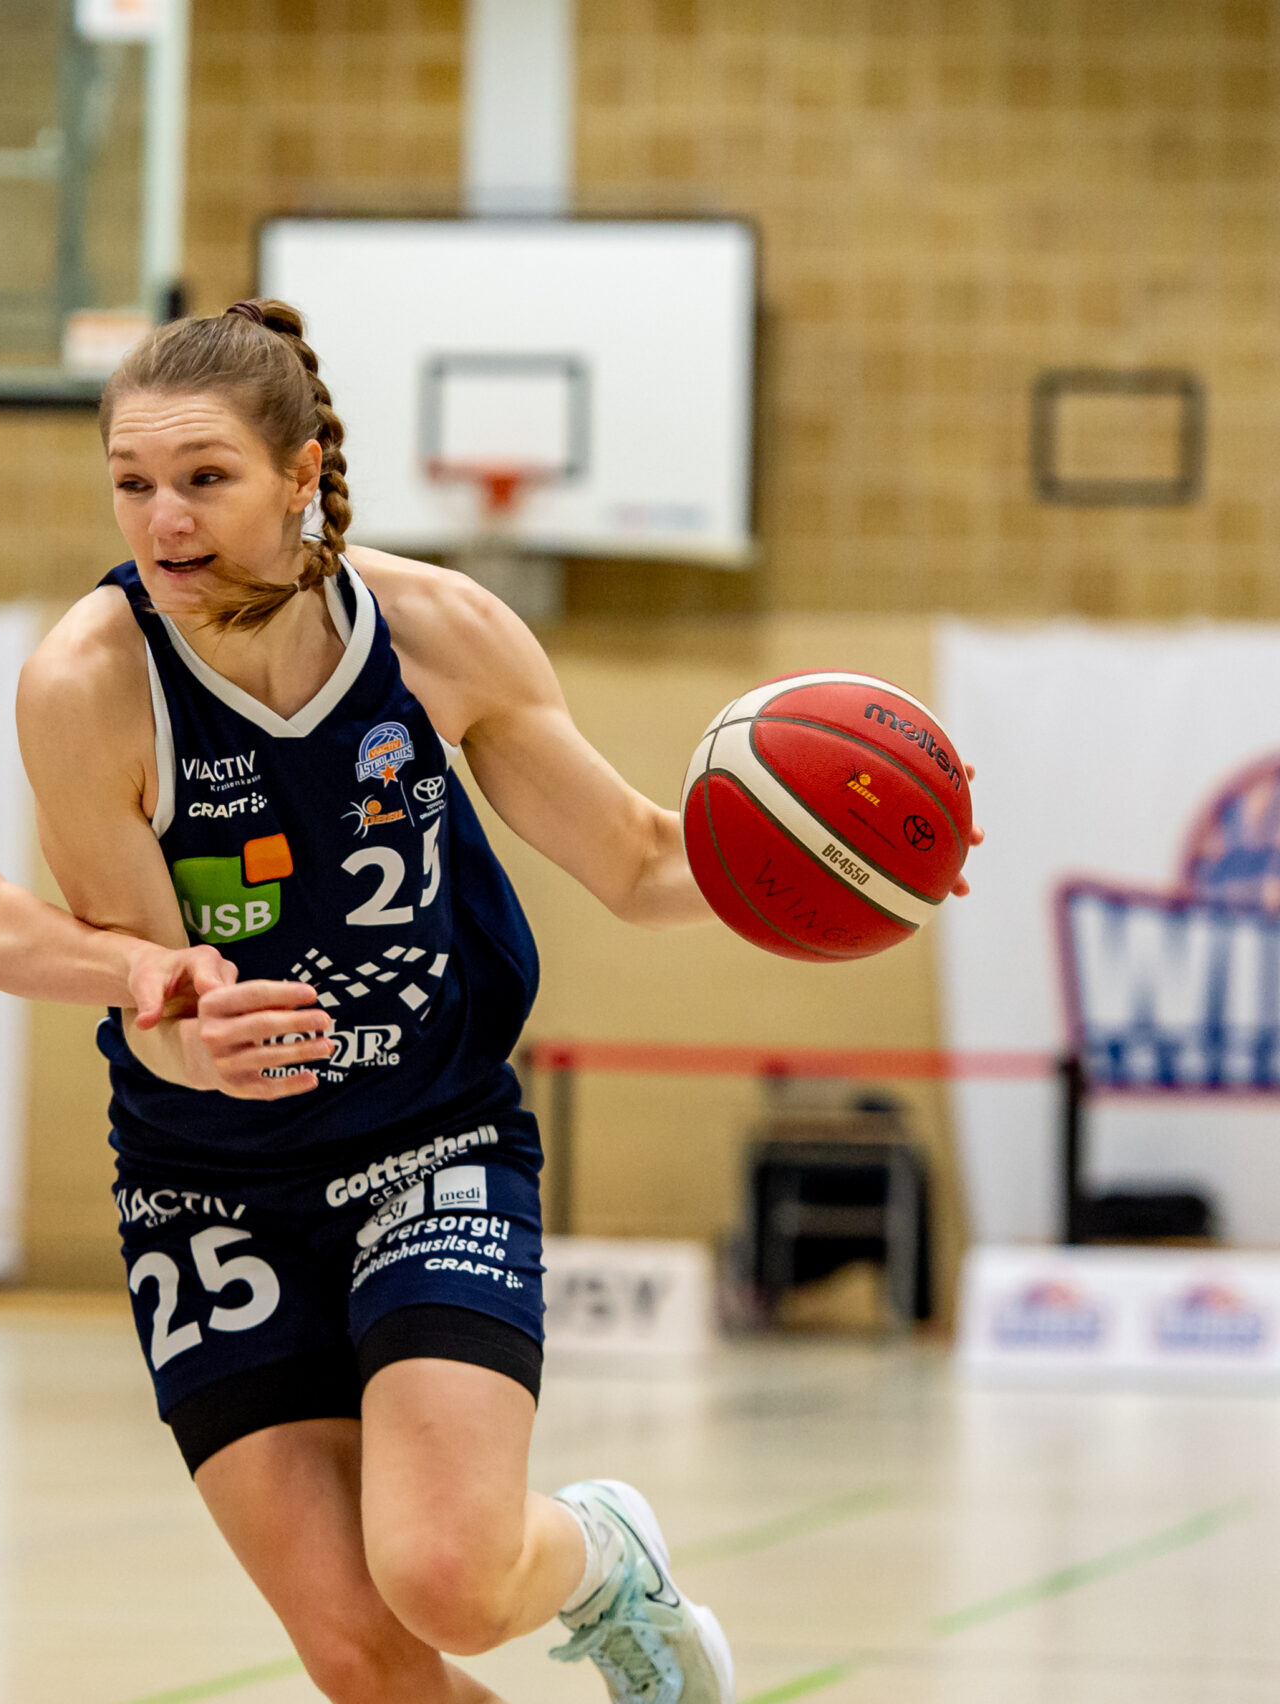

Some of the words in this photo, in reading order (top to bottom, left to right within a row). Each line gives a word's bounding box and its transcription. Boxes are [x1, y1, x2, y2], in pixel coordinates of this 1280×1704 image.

[863, 702, 962, 792] molten
[182, 750, 256, 783] VIACTIV
[188, 797, 249, 818] CRAFT
[821, 843, 870, 886] BG4550
[183, 900, 272, 937] USB
[440, 1187, 481, 1202] medi
[386, 1215, 511, 1244] versorgt!
[425, 1258, 505, 1281] CRAFT
[128, 1226, 280, 1371] 25
